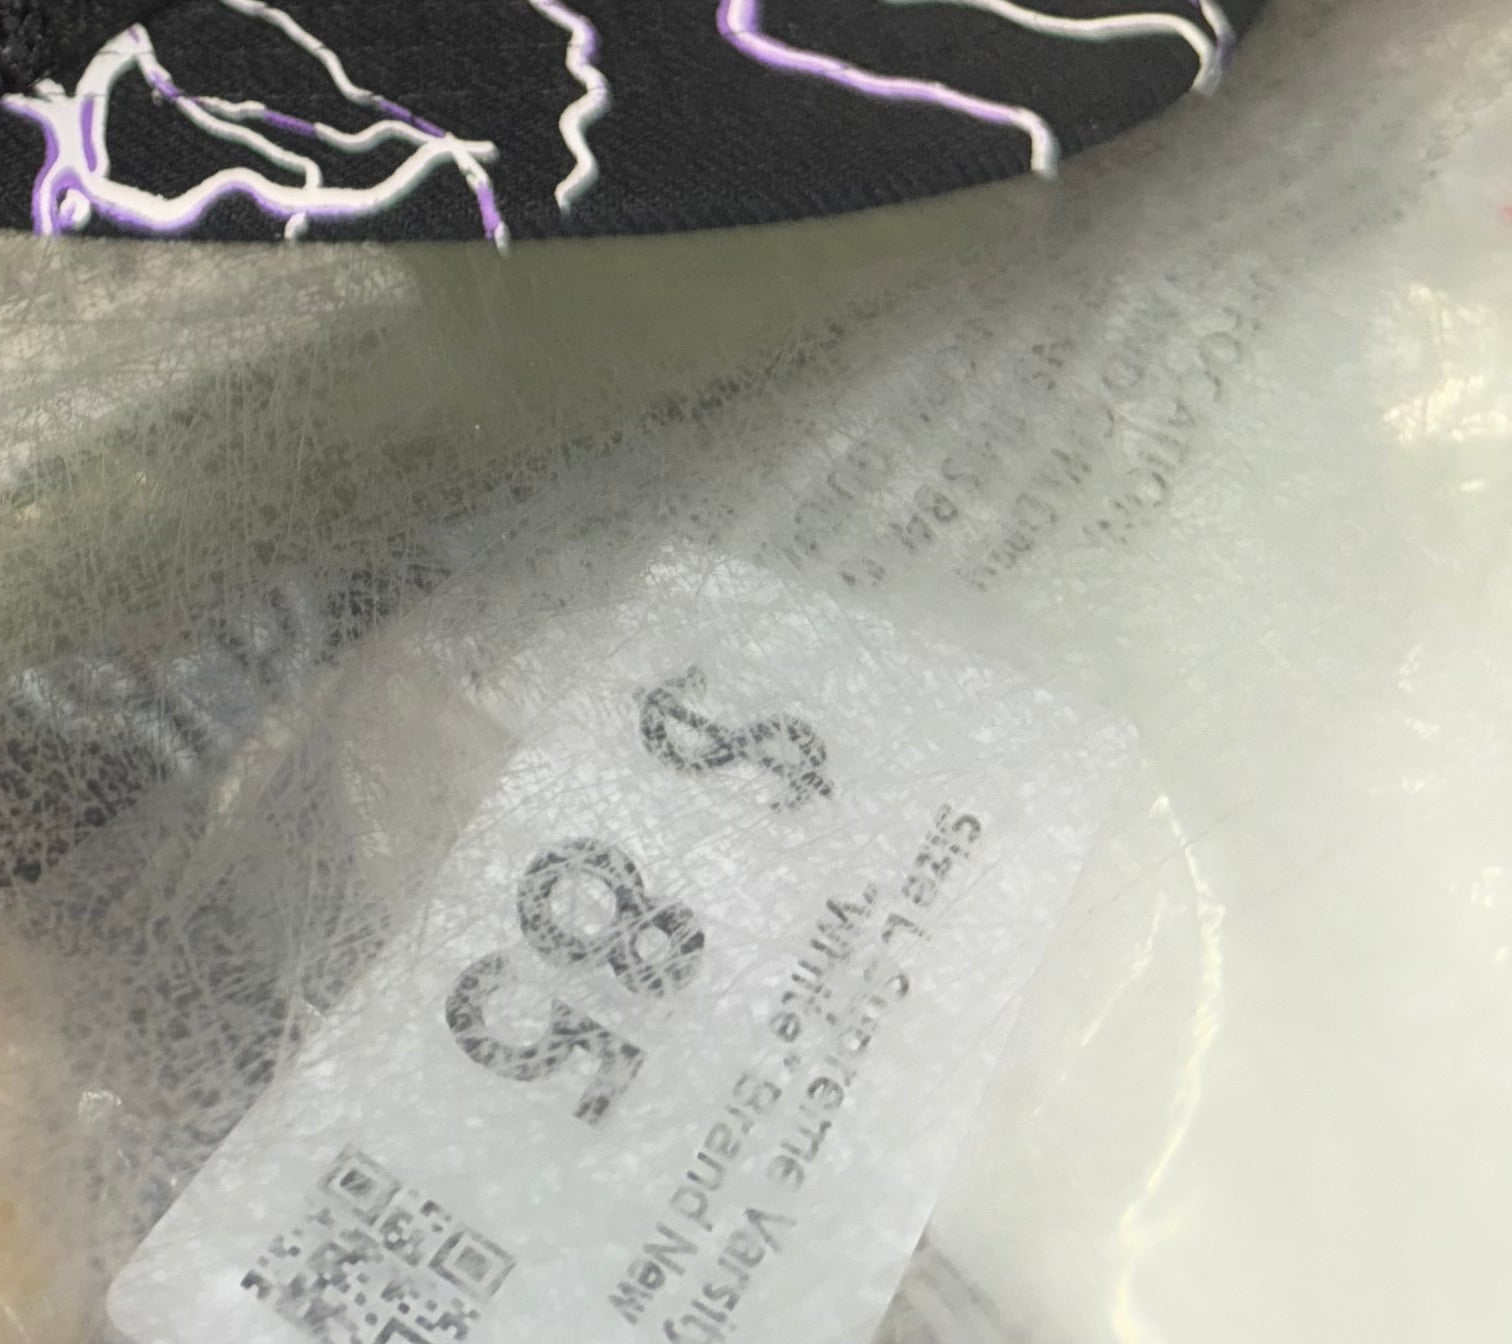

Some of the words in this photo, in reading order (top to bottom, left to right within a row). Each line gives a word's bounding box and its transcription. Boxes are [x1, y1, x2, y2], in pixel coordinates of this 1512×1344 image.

[902, 803, 982, 906] Size
[445, 835, 706, 1127] 85
[881, 912, 931, 944] L
[767, 957, 911, 1191] Supreme
[669, 1070, 783, 1233] Brand
[607, 1221, 699, 1327] New
